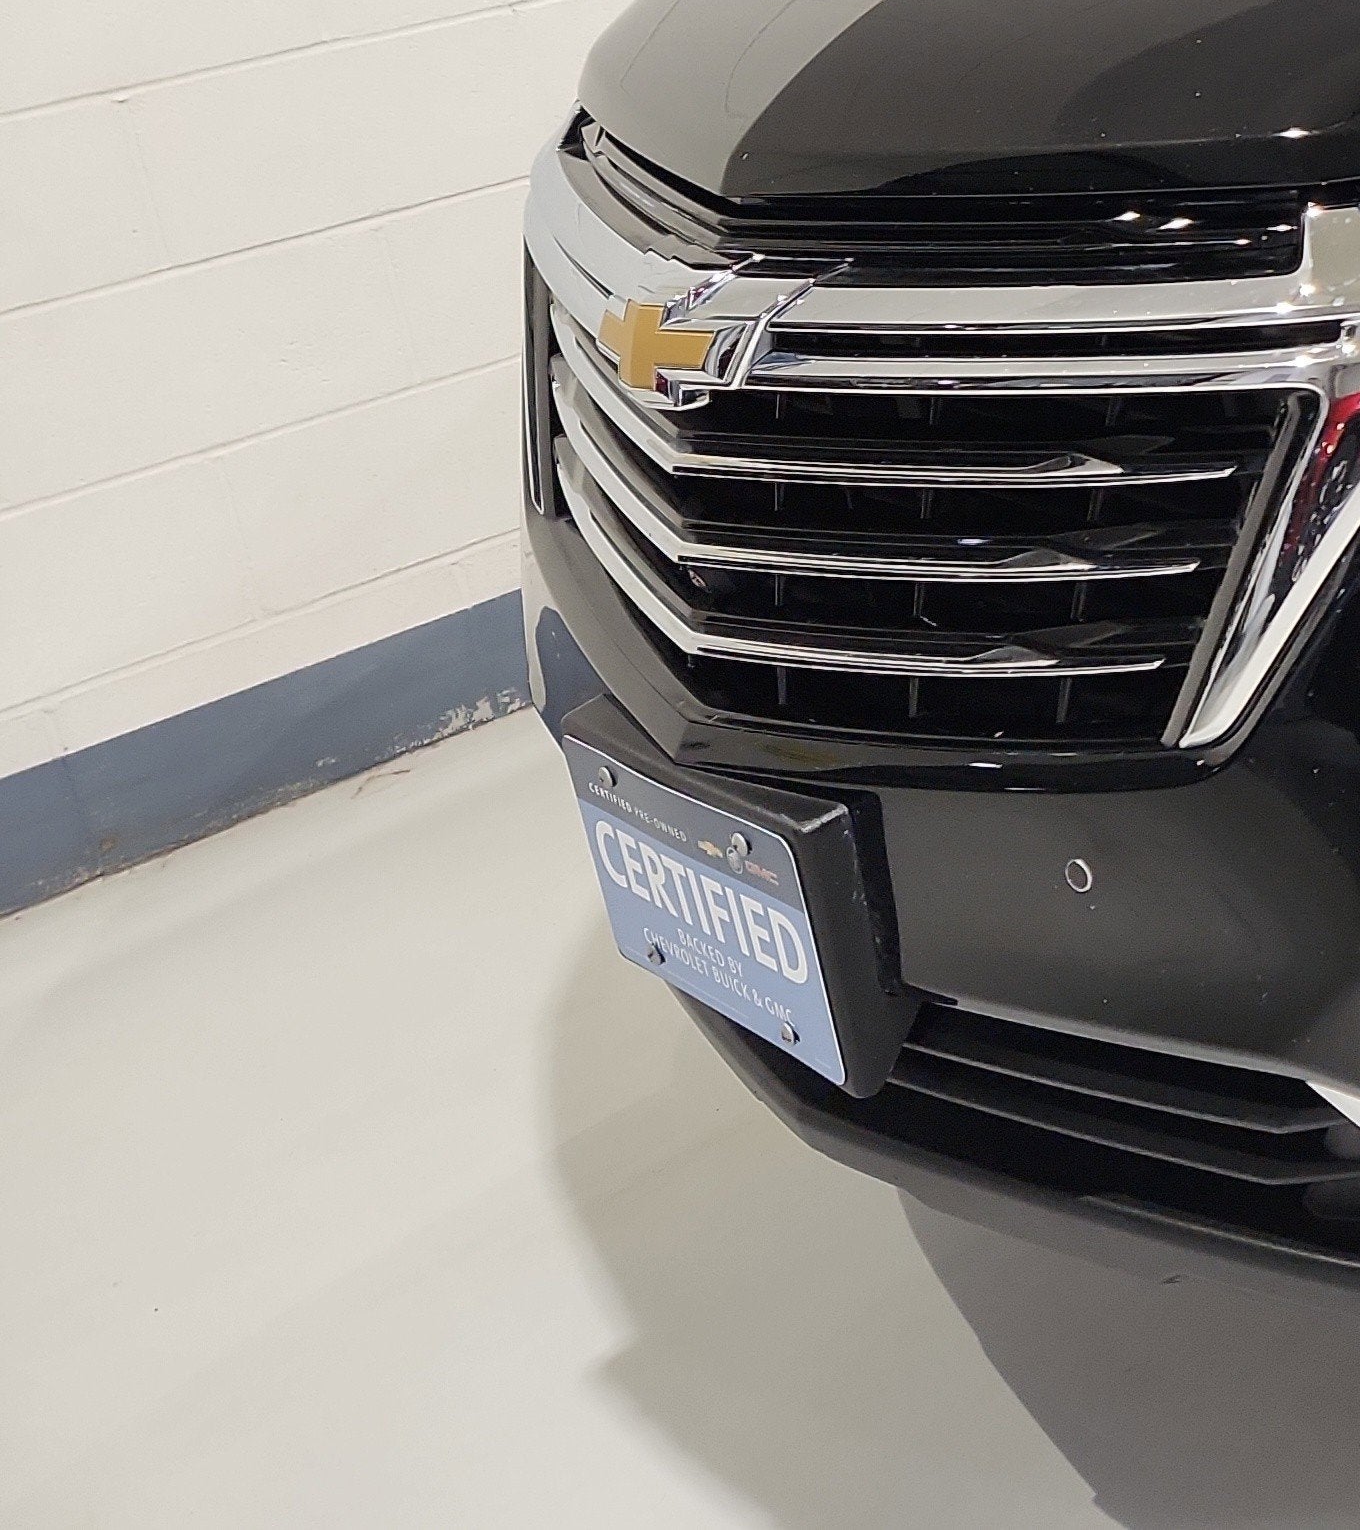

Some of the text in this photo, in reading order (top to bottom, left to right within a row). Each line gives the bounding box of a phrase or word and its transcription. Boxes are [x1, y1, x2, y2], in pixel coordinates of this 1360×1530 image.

[588, 782, 632, 813] CERTIFIED
[595, 820, 809, 984] CERTIFIED
[643, 927, 709, 978] CHEVROLET
[711, 965, 751, 1002] BUICK
[764, 996, 796, 1028] GMC
[677, 928, 744, 978] BACKED BY
